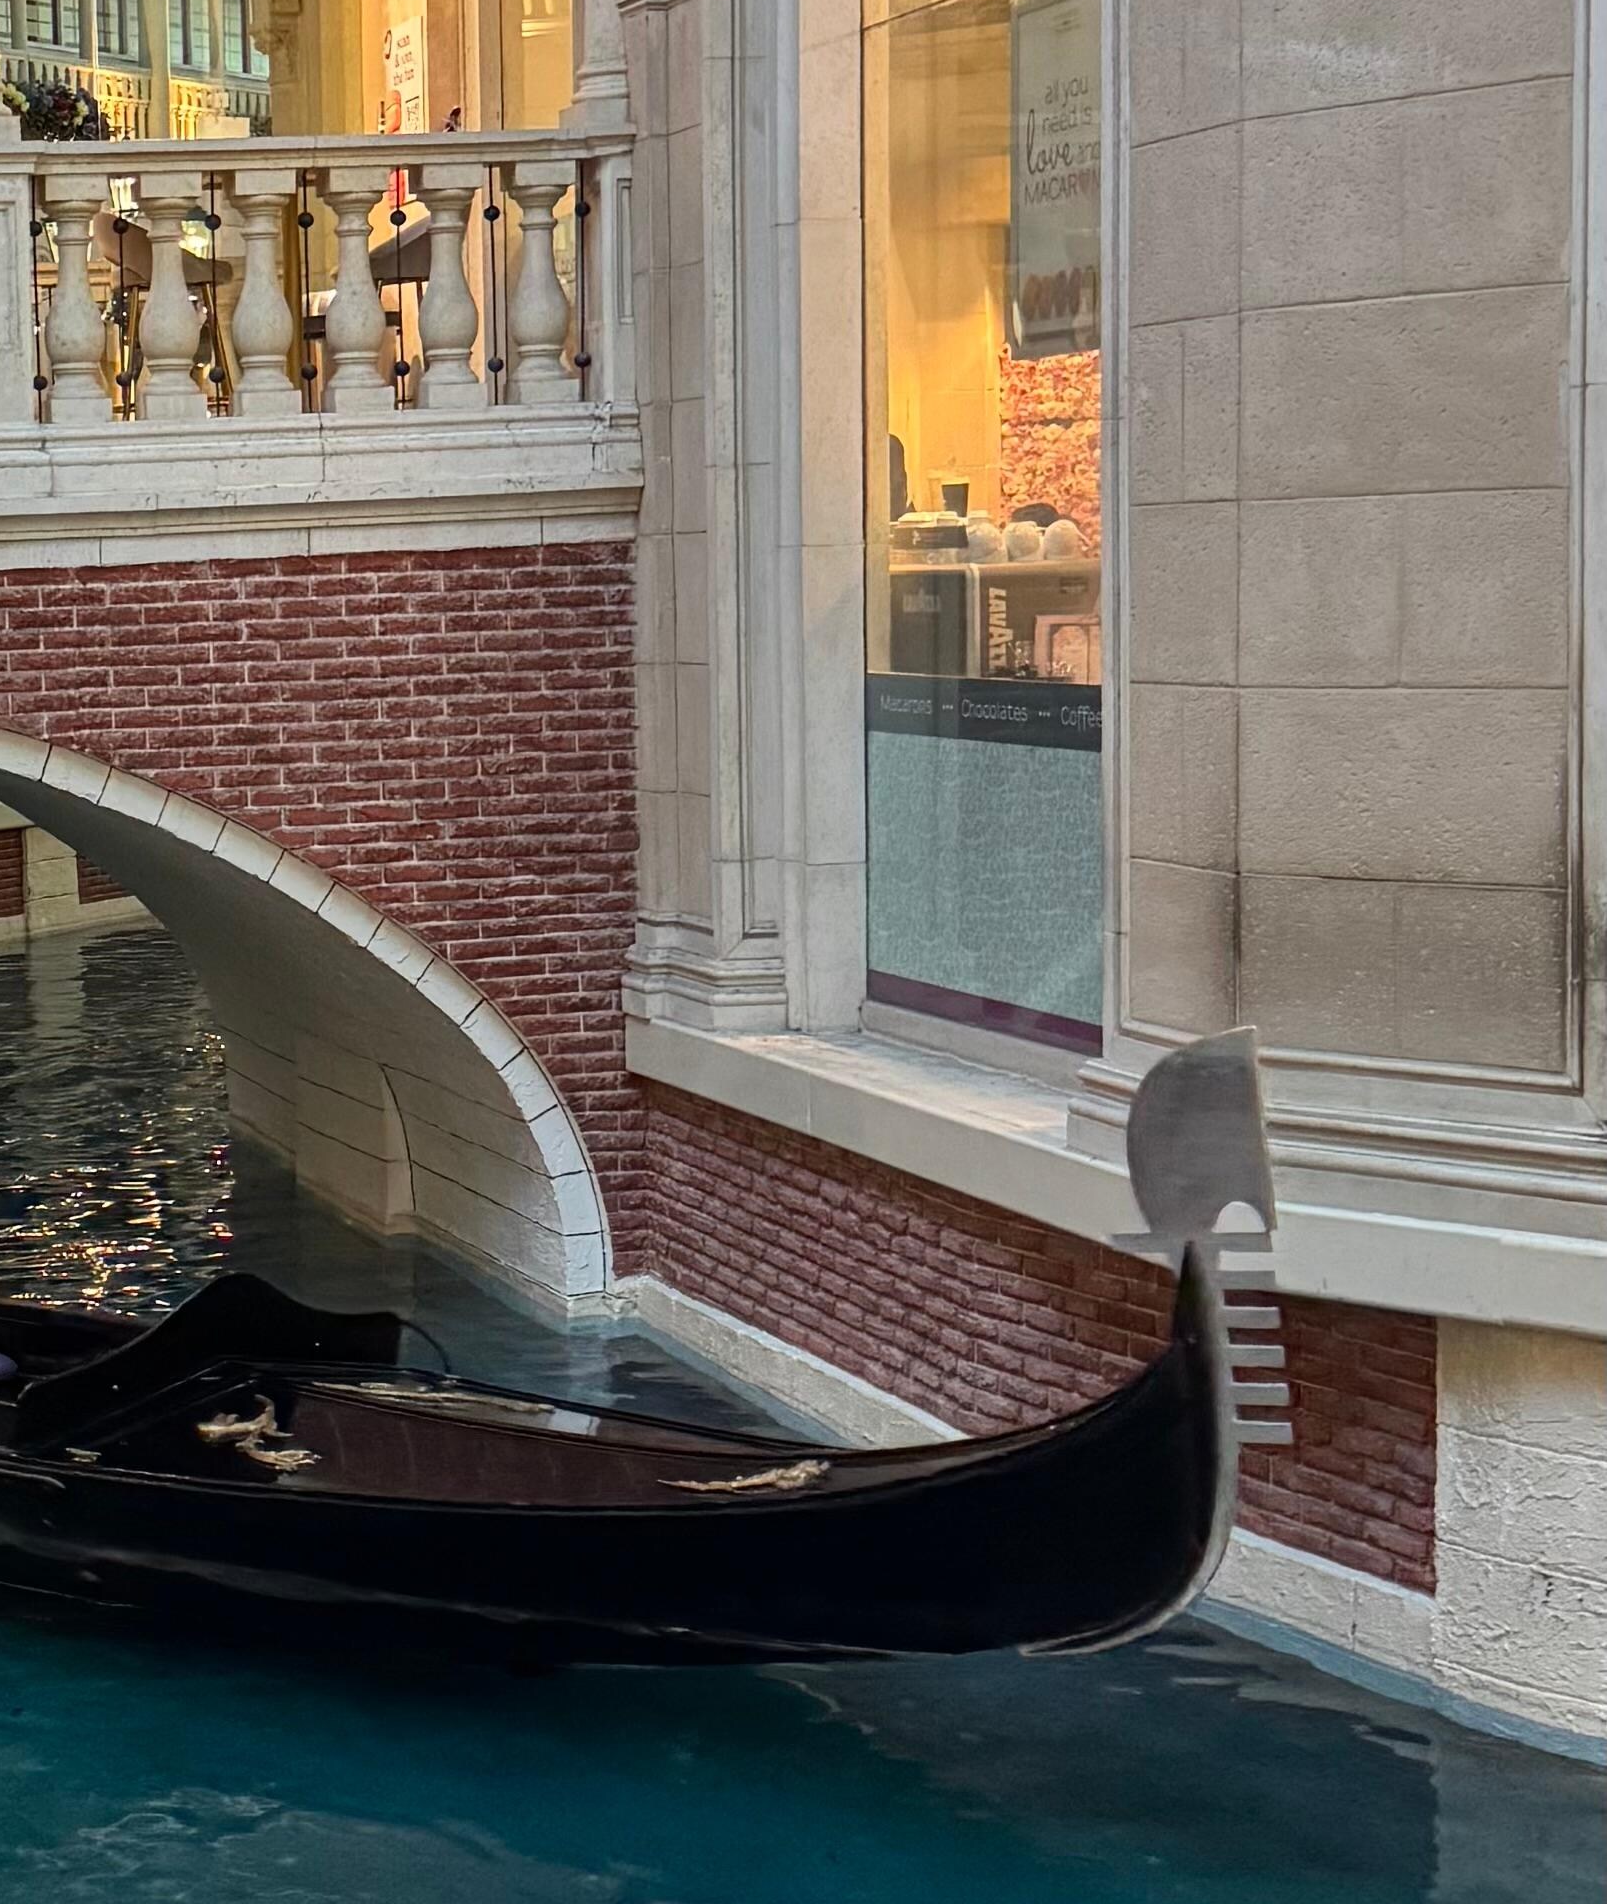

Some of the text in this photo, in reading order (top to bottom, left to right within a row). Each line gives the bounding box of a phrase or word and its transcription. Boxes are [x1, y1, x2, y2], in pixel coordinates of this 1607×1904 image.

[1062, 76, 1089, 109] you
[1026, 108, 1074, 176] love
[960, 698, 1029, 722] Chocolates
